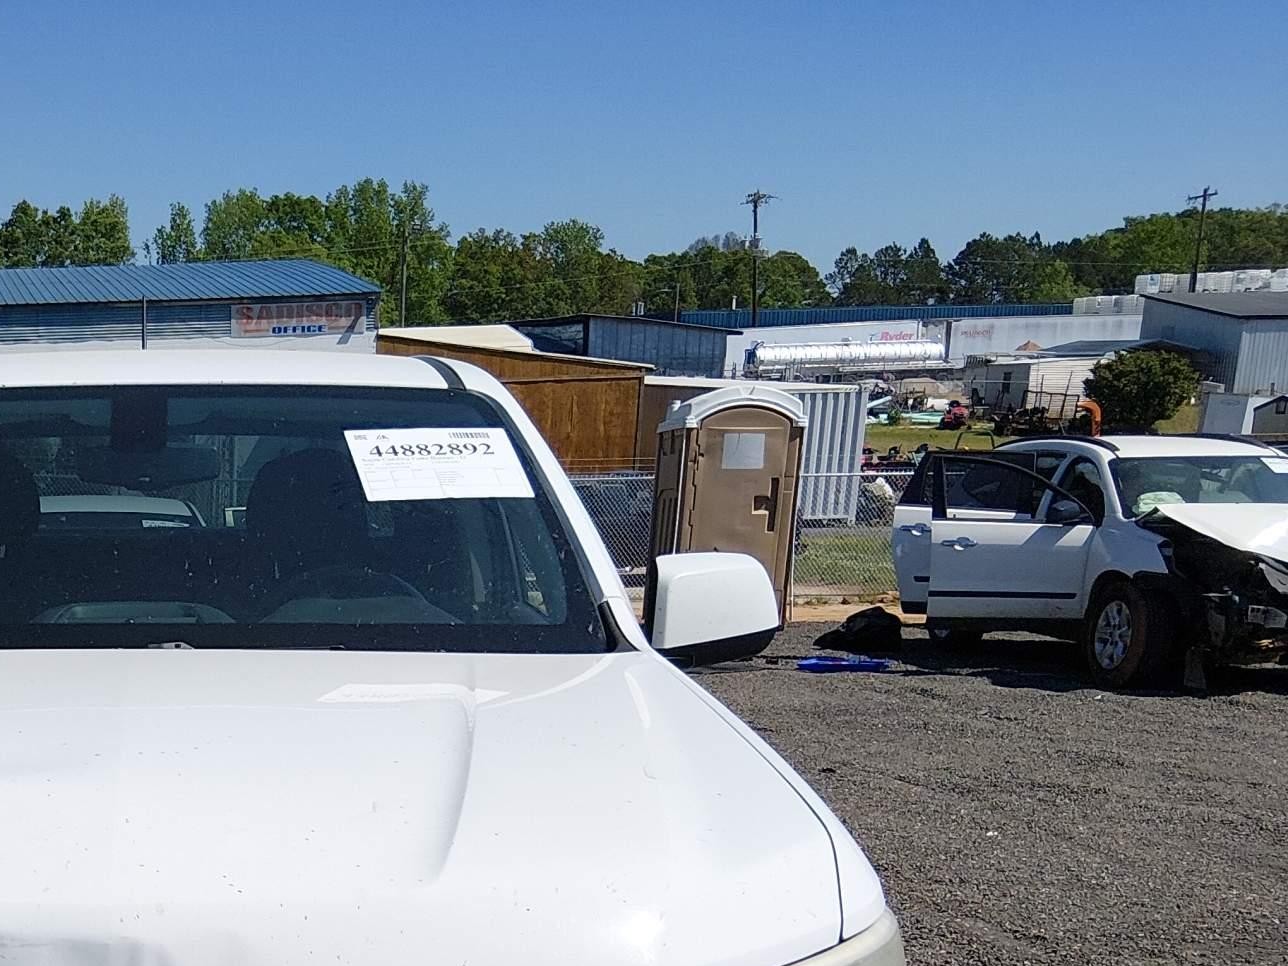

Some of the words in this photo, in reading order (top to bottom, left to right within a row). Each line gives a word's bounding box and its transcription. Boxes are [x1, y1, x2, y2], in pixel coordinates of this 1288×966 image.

[271, 324, 328, 335] OFFICE
[879, 331, 913, 341] Ryder
[369, 442, 495, 458] 44882892
